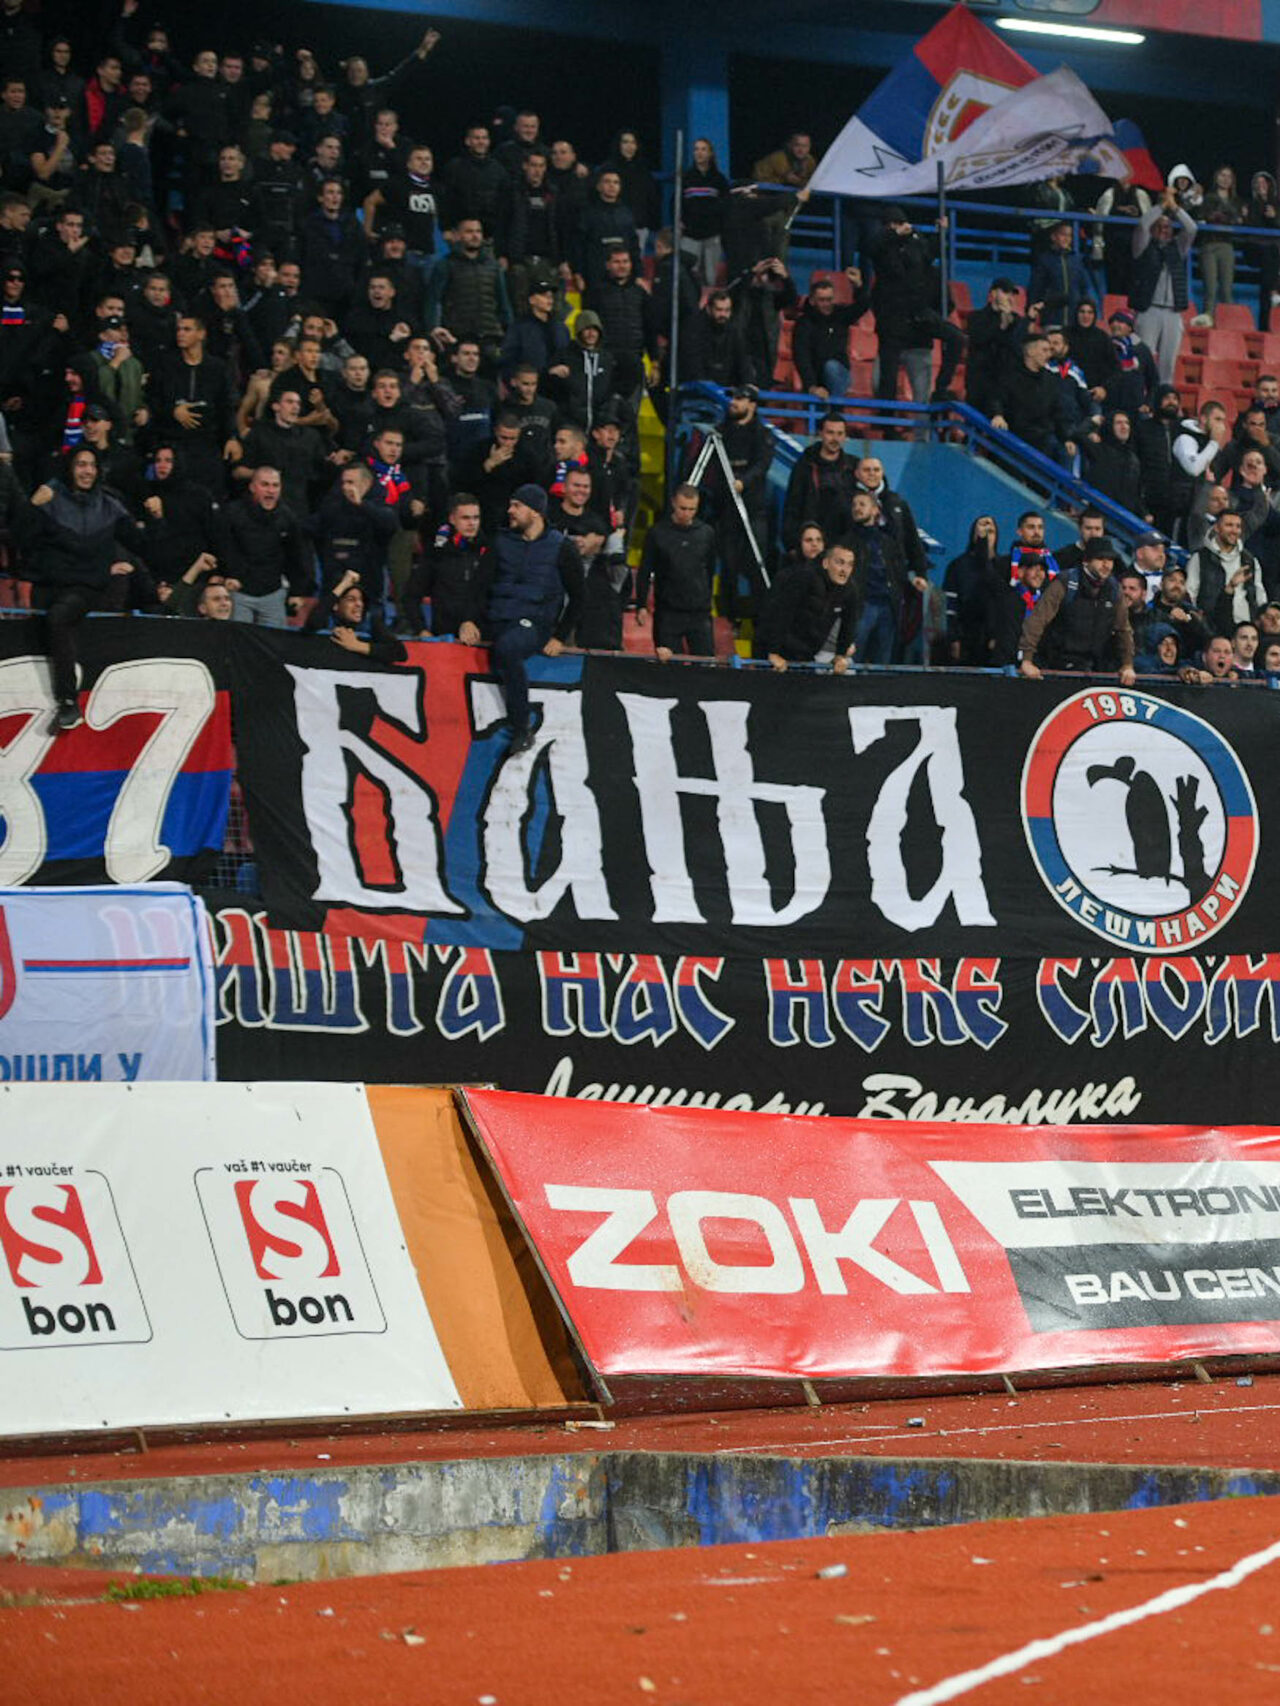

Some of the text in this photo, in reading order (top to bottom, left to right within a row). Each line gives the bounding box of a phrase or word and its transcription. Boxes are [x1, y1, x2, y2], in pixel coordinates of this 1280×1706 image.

[1082, 694, 1160, 720] 1987
[284, 664, 998, 931] БАЊА
[1055, 872, 1240, 945] ЛЕШИНАРИ
[25, 1162, 74, 1176] vaučer
[224, 1159, 312, 1173] vaš #1 vaučer
[544, 1183, 972, 1296] ZOKI
[21, 1297, 116, 1335] bon
[265, 1288, 354, 1325] bon
